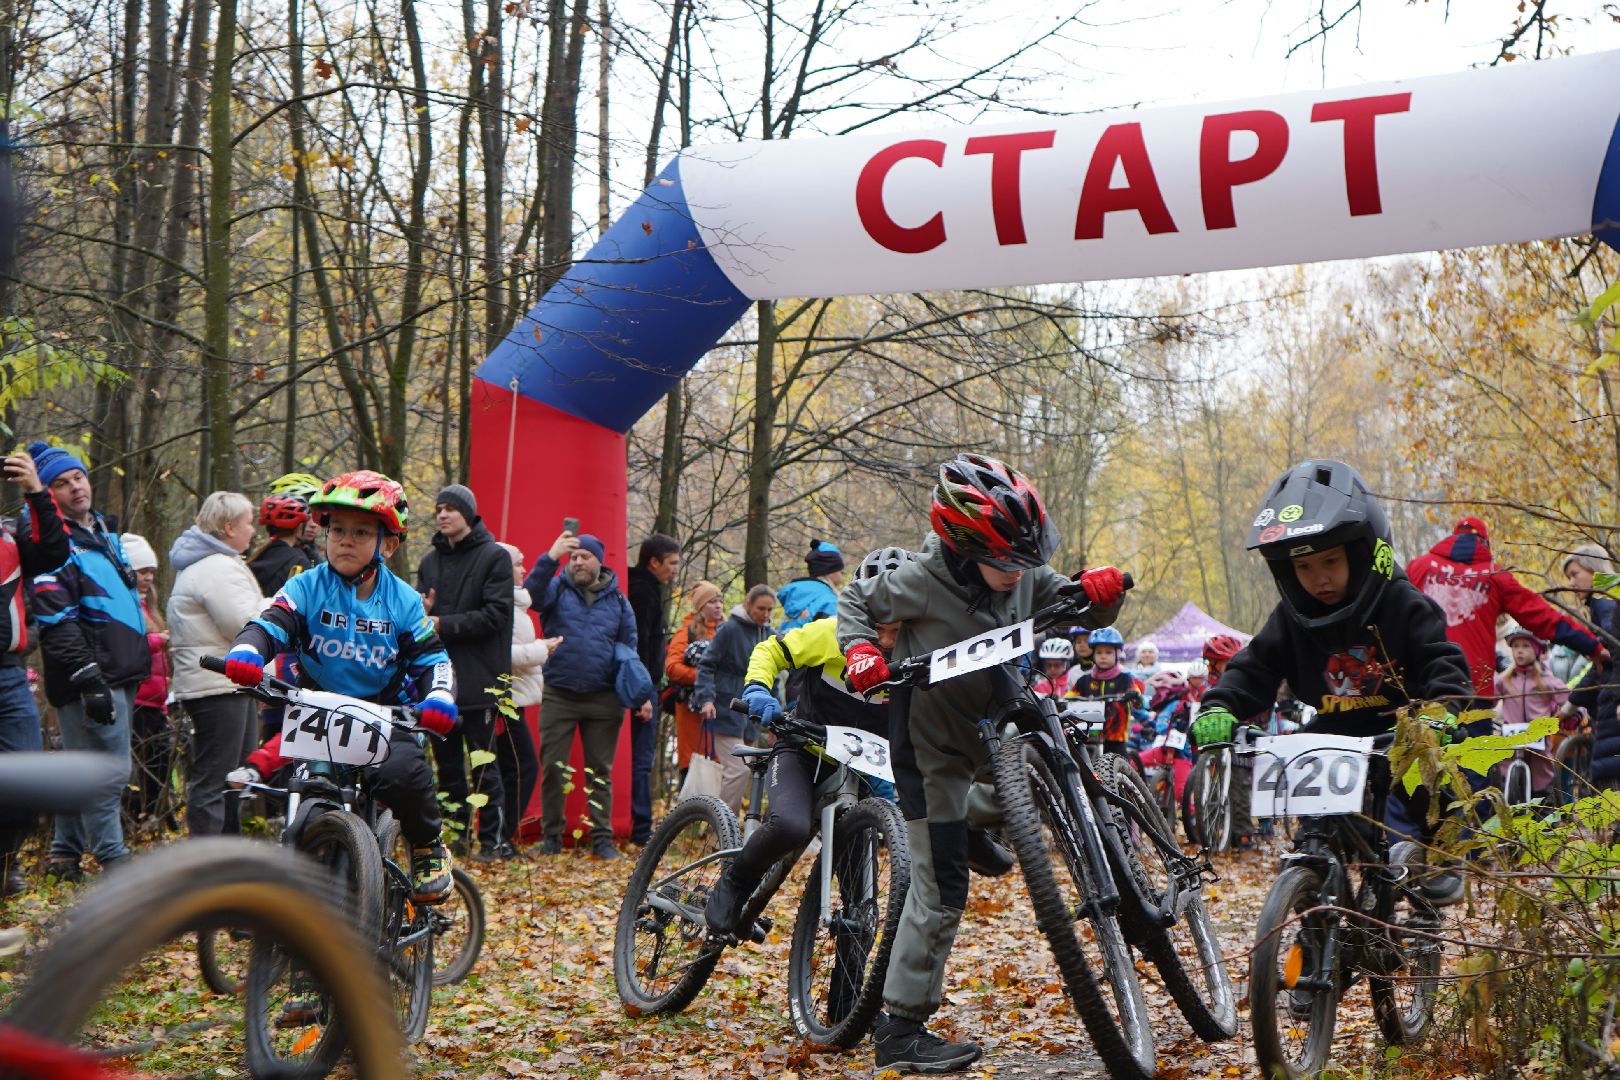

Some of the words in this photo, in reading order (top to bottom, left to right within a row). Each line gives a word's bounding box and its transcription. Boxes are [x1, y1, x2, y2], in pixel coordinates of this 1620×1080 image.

[855, 92, 1413, 254] СТАРТ
[1286, 523, 1325, 537] Leatt
[937, 627, 1022, 670] 101
[1257, 755, 1361, 799] 420
